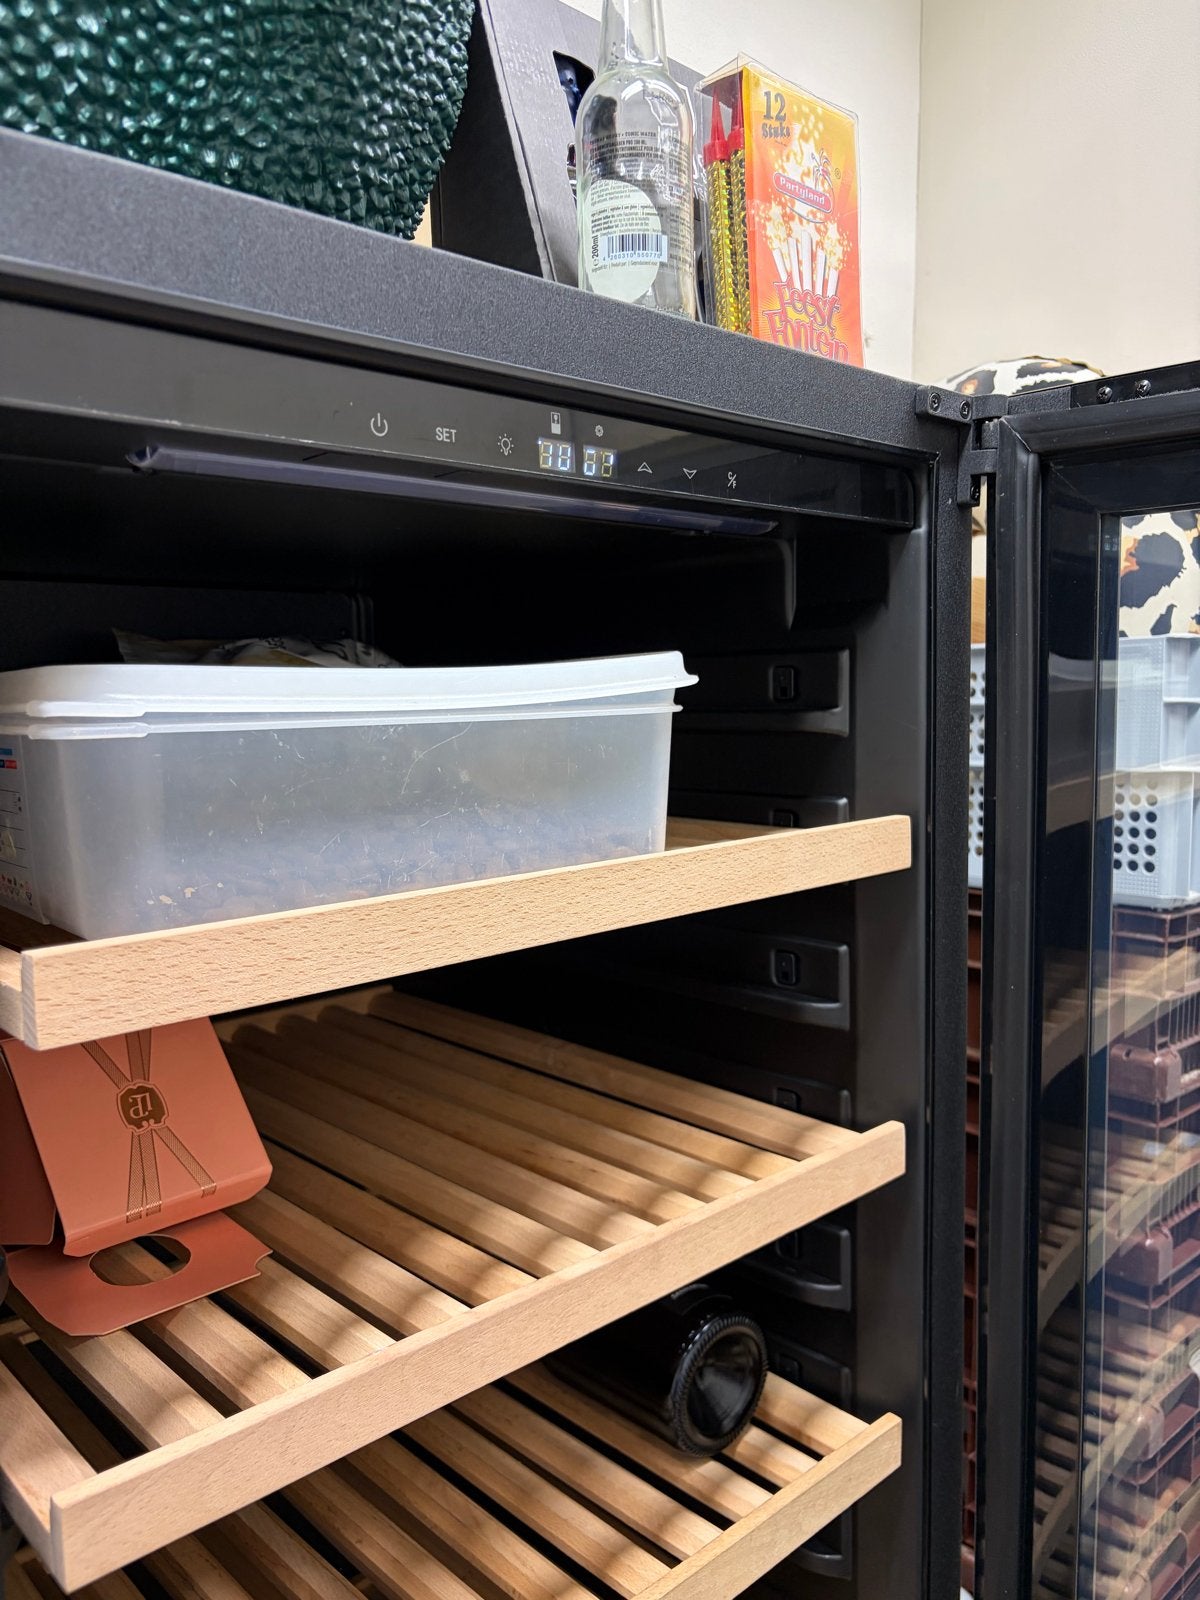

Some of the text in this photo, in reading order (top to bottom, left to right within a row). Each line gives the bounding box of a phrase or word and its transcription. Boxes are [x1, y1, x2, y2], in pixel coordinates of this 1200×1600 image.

[763, 90, 787, 122] 12
[762, 122, 791, 139] Stuks
[779, 176, 825, 205] Partyland
[591, 234, 599, 259] 200ml
[610, 252, 634, 260] 260310
[773, 275, 840, 338] Feest
[435, 426, 457, 444] SET
[727, 471, 737, 489] C/F
